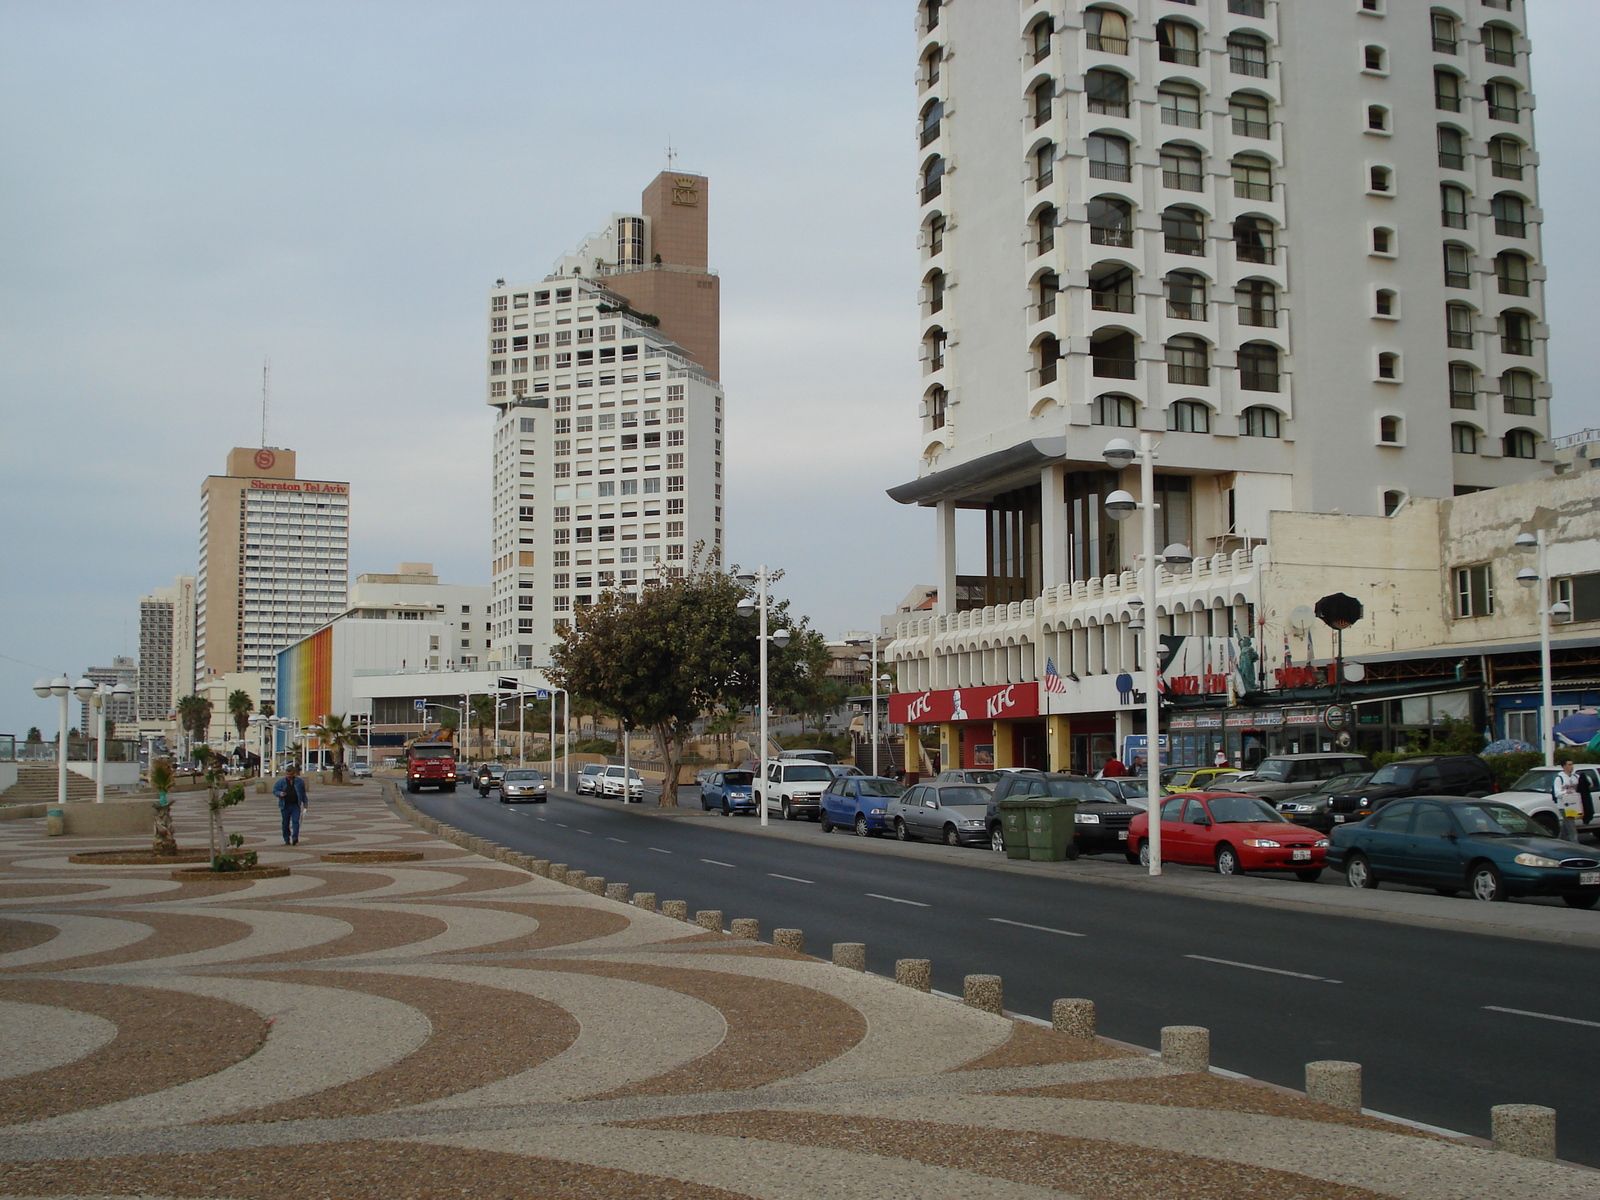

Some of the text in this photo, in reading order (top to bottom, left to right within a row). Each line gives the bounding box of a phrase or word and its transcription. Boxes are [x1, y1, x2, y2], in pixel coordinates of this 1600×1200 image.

[672, 189, 698, 204] KD
[250, 480, 346, 493] Sheraton Tel Aviv
[985, 684, 1015, 718] KFC
[1131, 688, 1147, 704] Yam
[907, 691, 931, 722] KFC
